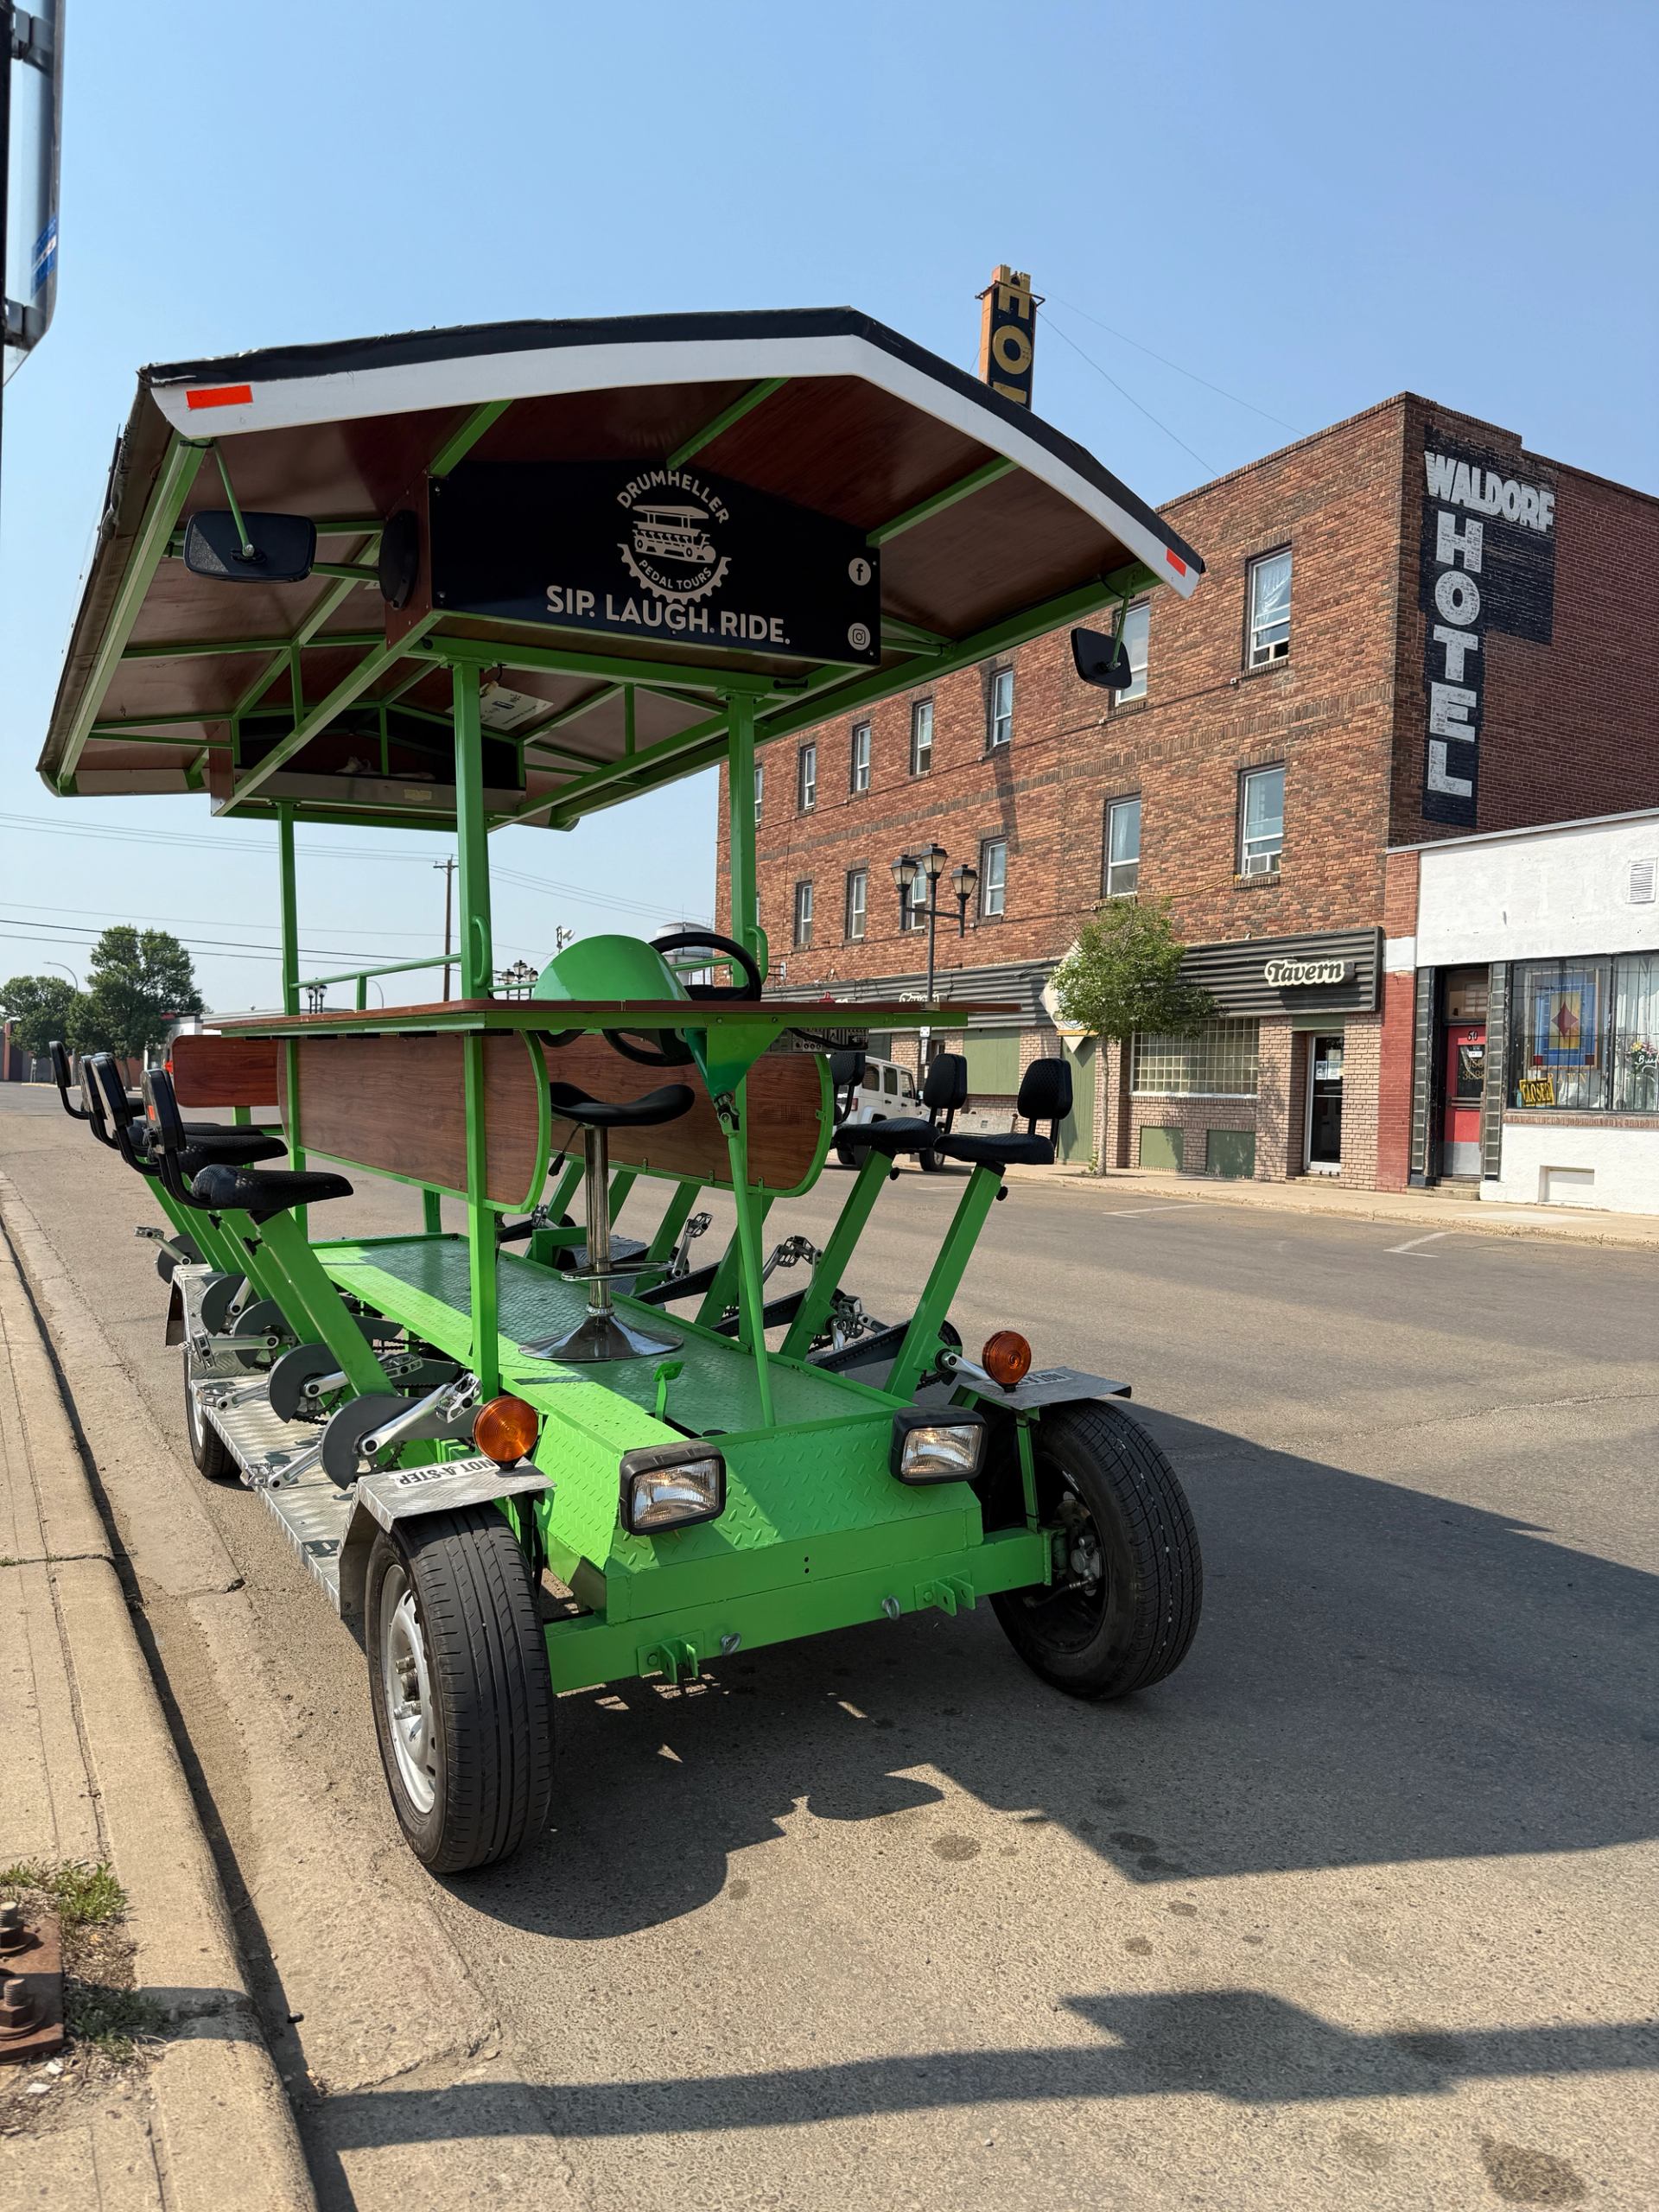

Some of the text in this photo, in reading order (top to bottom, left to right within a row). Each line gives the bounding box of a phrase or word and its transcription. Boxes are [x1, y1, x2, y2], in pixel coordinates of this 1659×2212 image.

[993, 265, 1032, 404] HO
[616, 470, 729, 524] DRUMHELLER
[1424, 450, 1554, 533] WALDORF
[639, 560, 712, 589] PEDAL TOURS
[546, 585, 791, 645] SIP. LAUGH. RIDE.
[1427, 510, 1483, 797] HOTEL
[1266, 961, 1344, 985] Tavern
[1522, 1082, 1551, 1103] CLOSED
[398, 1459, 496, 1485] NOT A STEP
